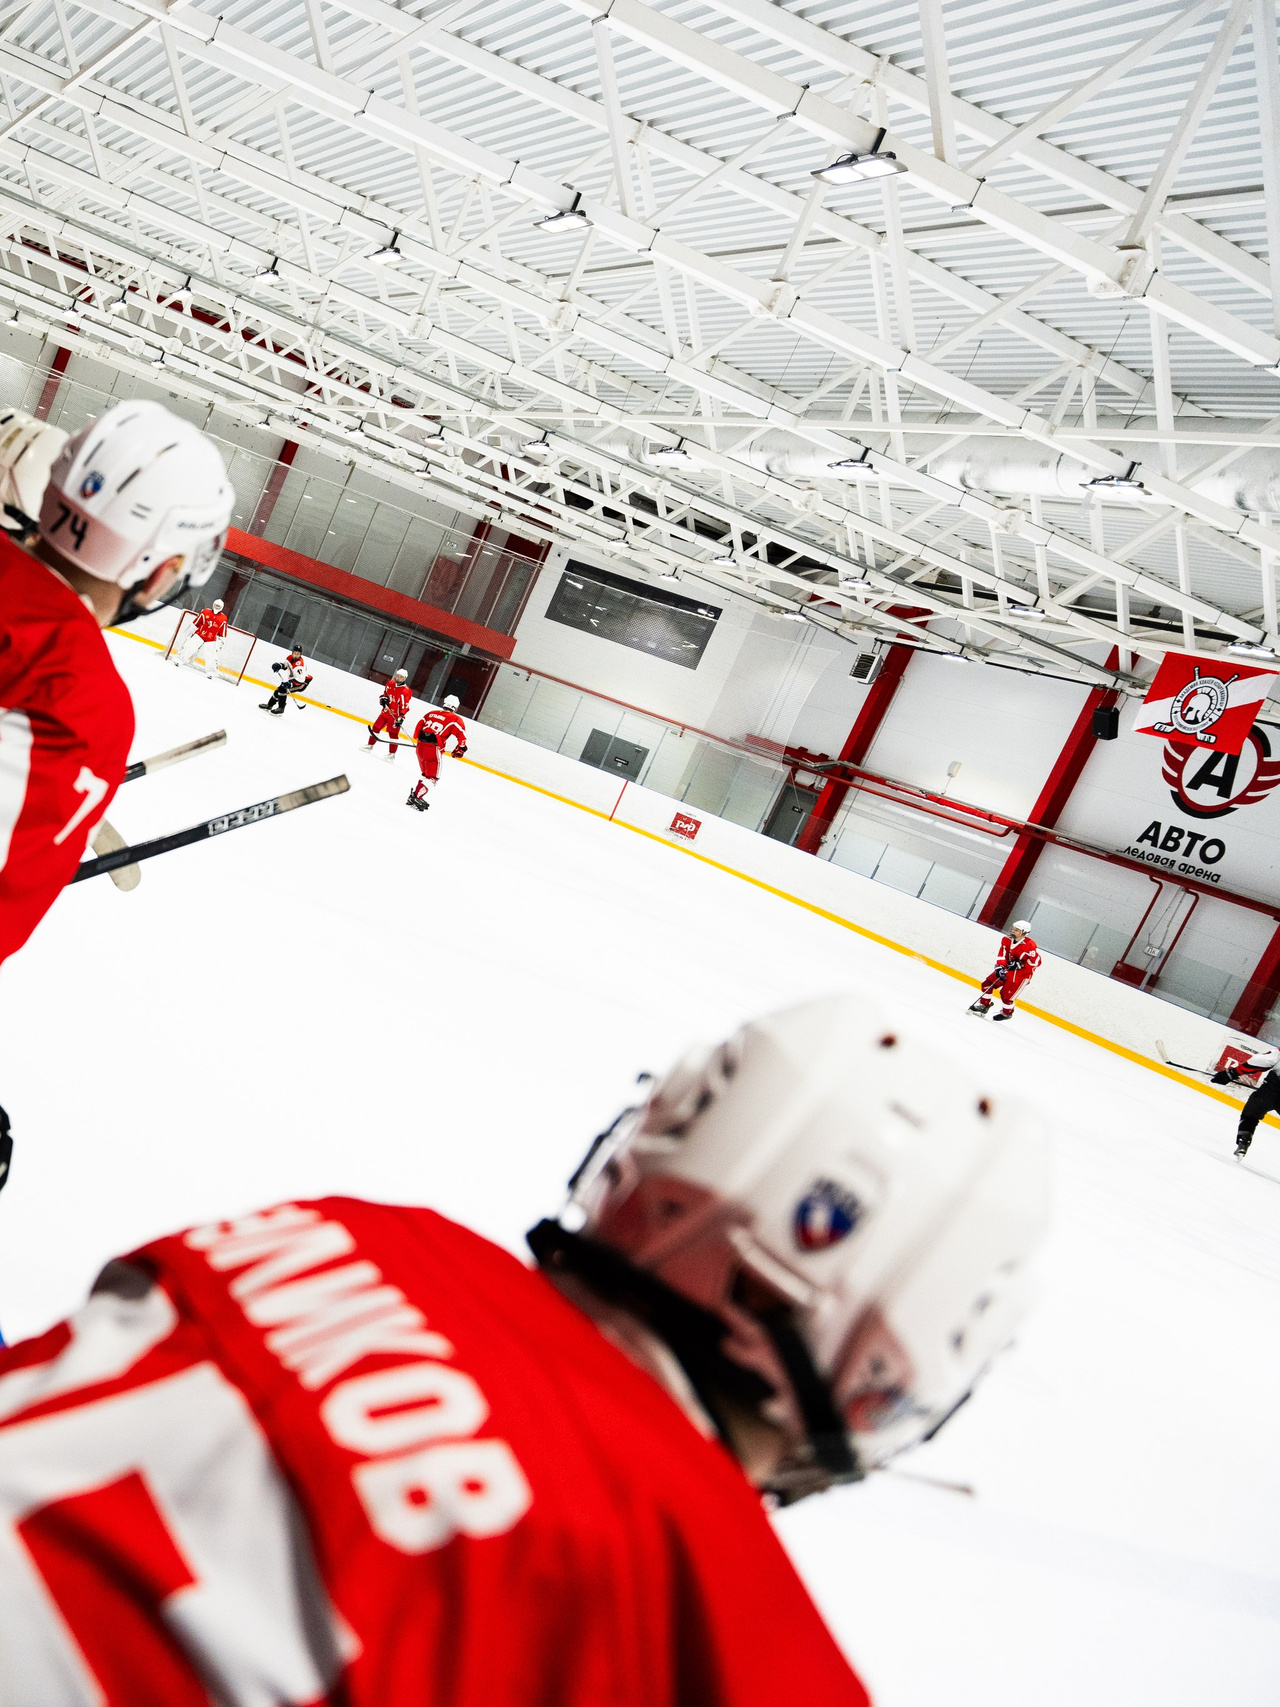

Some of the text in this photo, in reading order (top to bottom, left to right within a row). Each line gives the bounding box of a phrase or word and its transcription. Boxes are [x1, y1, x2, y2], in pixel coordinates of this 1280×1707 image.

[50, 502, 88, 550] 74
[1123, 846, 1221, 884] ледовая арена
[1136, 821, 1226, 865] АВТО
